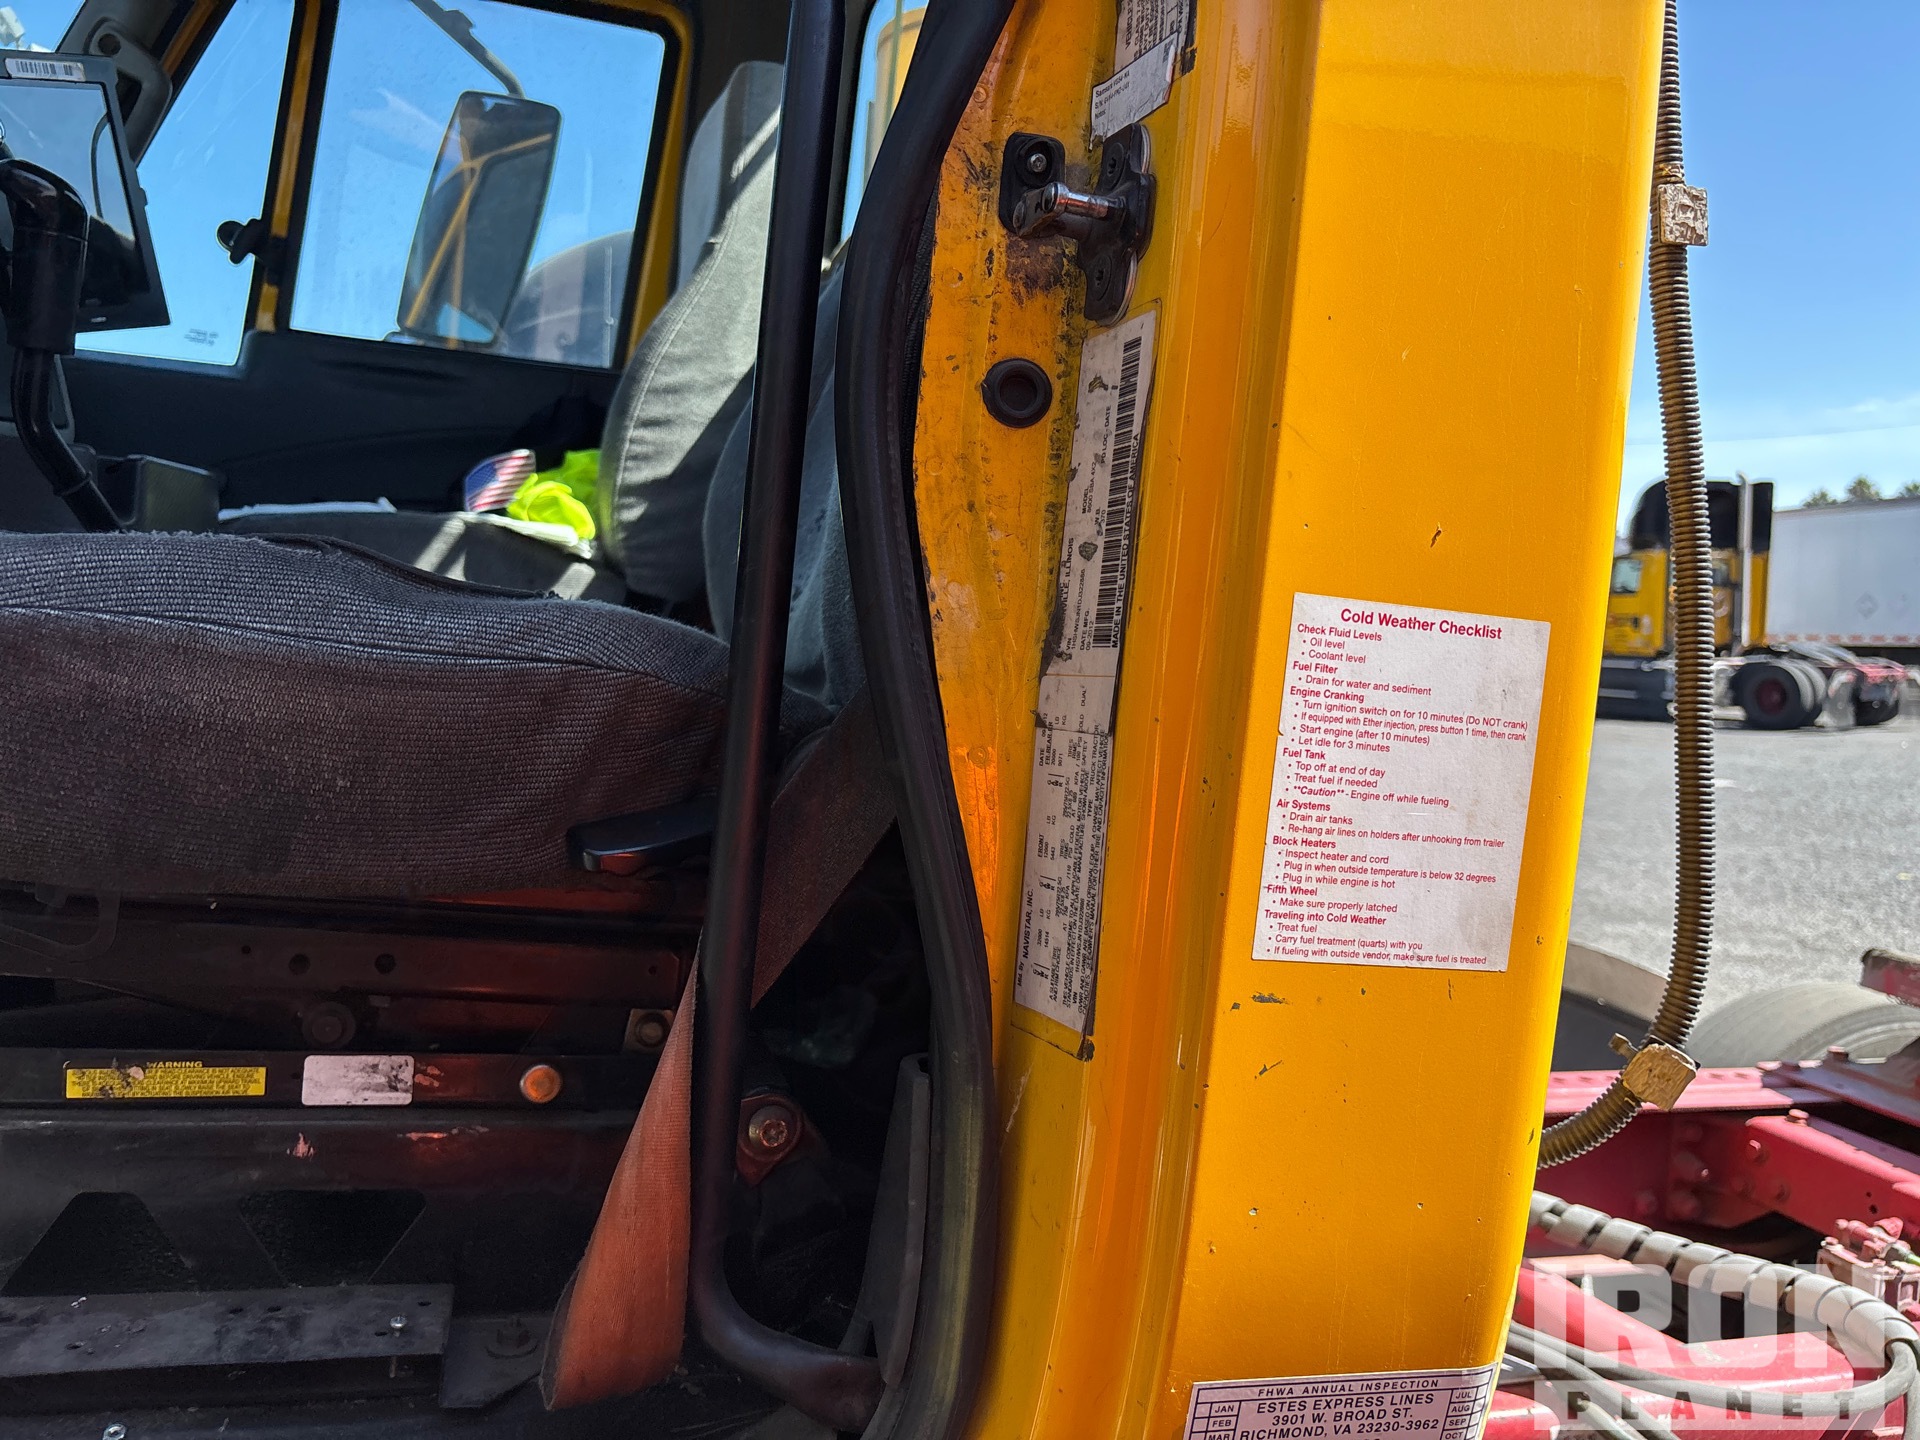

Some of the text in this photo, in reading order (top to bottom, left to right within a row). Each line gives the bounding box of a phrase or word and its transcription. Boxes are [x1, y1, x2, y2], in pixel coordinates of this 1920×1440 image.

[1129, 433, 1139, 481] AMERICA
[1119, 541, 1129, 581] UNITED
[1116, 583, 1125, 603] THE
[1115, 606, 1122, 616] IN
[1340, 608, 1502, 639] Cold Weather Checklist
[1086, 621, 1094, 650] 09-2012
[1112, 619, 1121, 648] MADE
[1297, 623, 1382, 640] Check Fluid Levels
[1080, 629, 1088, 650] DATE
[1309, 637, 1344, 648] Oil level
[1308, 649, 1366, 662] Coolant level
[1293, 661, 1337, 672] Fuel Filter
[1306, 675, 1431, 694] Drain for water and sediment
[1290, 686, 1364, 702] Engine Cranking
[1303, 700, 1321, 708] Turn
[1324, 702, 1356, 713] ignition
[1360, 705, 1387, 715] switch
[1403, 709, 1414, 717] for
[1418, 711, 1427, 719] 10
[1430, 712, 1463, 722] minutes
[1465, 715, 1480, 725] (Do
[1482, 717, 1500, 725] NOT
[1502, 719, 1527, 730] crank)
[1300, 724, 1429, 744] Start engine (after 10 minutes)
[1298, 736, 1390, 751] Let idle for 3 minutes
[1283, 747, 1325, 758] Fuel Tank
[1295, 761, 1310, 771] Top
[1314, 762, 1326, 770] off
[1339, 764, 1356, 773] end
[1358, 766, 1367, 774] of
[1369, 767, 1385, 777] day
[1277, 798, 1330, 811] Air Systems
[1350, 790, 1381, 801] Engine
[1382, 792, 1394, 800] off
[1397, 793, 1417, 802] while
[1420, 795, 1449, 806] fueling
[1290, 812, 1311, 820] Drain
[1329, 815, 1352, 823] tanks
[1272, 835, 1336, 847] Block Heaters
[1288, 823, 1322, 835] Re-hang
[1325, 826, 1334, 834] air
[1337, 827, 1355, 835] lines
[1370, 830, 1399, 839] holders
[1402, 832, 1419, 840] after
[1421, 833, 1461, 845] unhooking
[1463, 836, 1480, 844] from
[1483, 838, 1504, 846] trailer
[1285, 849, 1389, 863] Inspect heater and cord
[1283, 873, 1302, 883] Plug
[1305, 874, 1312, 882] in
[1315, 875, 1338, 883] while
[1339, 877, 1369, 887] engine
[1381, 879, 1395, 887] hot
[1266, 884, 1317, 894] Fifth Wheel
[1279, 897, 1303, 906] Make
[1327, 900, 1363, 911] properly
[1366, 902, 1397, 911] latched
[1264, 909, 1386, 923] Traveling into Cold Weather
[1022, 909, 1032, 959] NAVISTAR,
[1277, 922, 1316, 931] Treat fuel
[1275, 934, 1422, 950] Carry fuel treatment (quarts) with you
[146, 1060, 203, 1069] WARNING
[1258, 1380, 1439, 1397] FHWA ANNUAL INSPECTION
[1455, 1390, 1472, 1399] JUL
[1214, 1405, 1235, 1413] JAN
[1257, 1393, 1435, 1413] ESTES EXPRESS LINES
[1451, 1405, 1470, 1413] AUG
[1212, 1420, 1232, 1428] FEB
[1272, 1407, 1413, 1426] 3901 W. BROAD ST.
[1240, 1419, 1439, 1440] RICHMOND, VA 23230-3962
[1445, 1432, 1463, 1440] OCT
